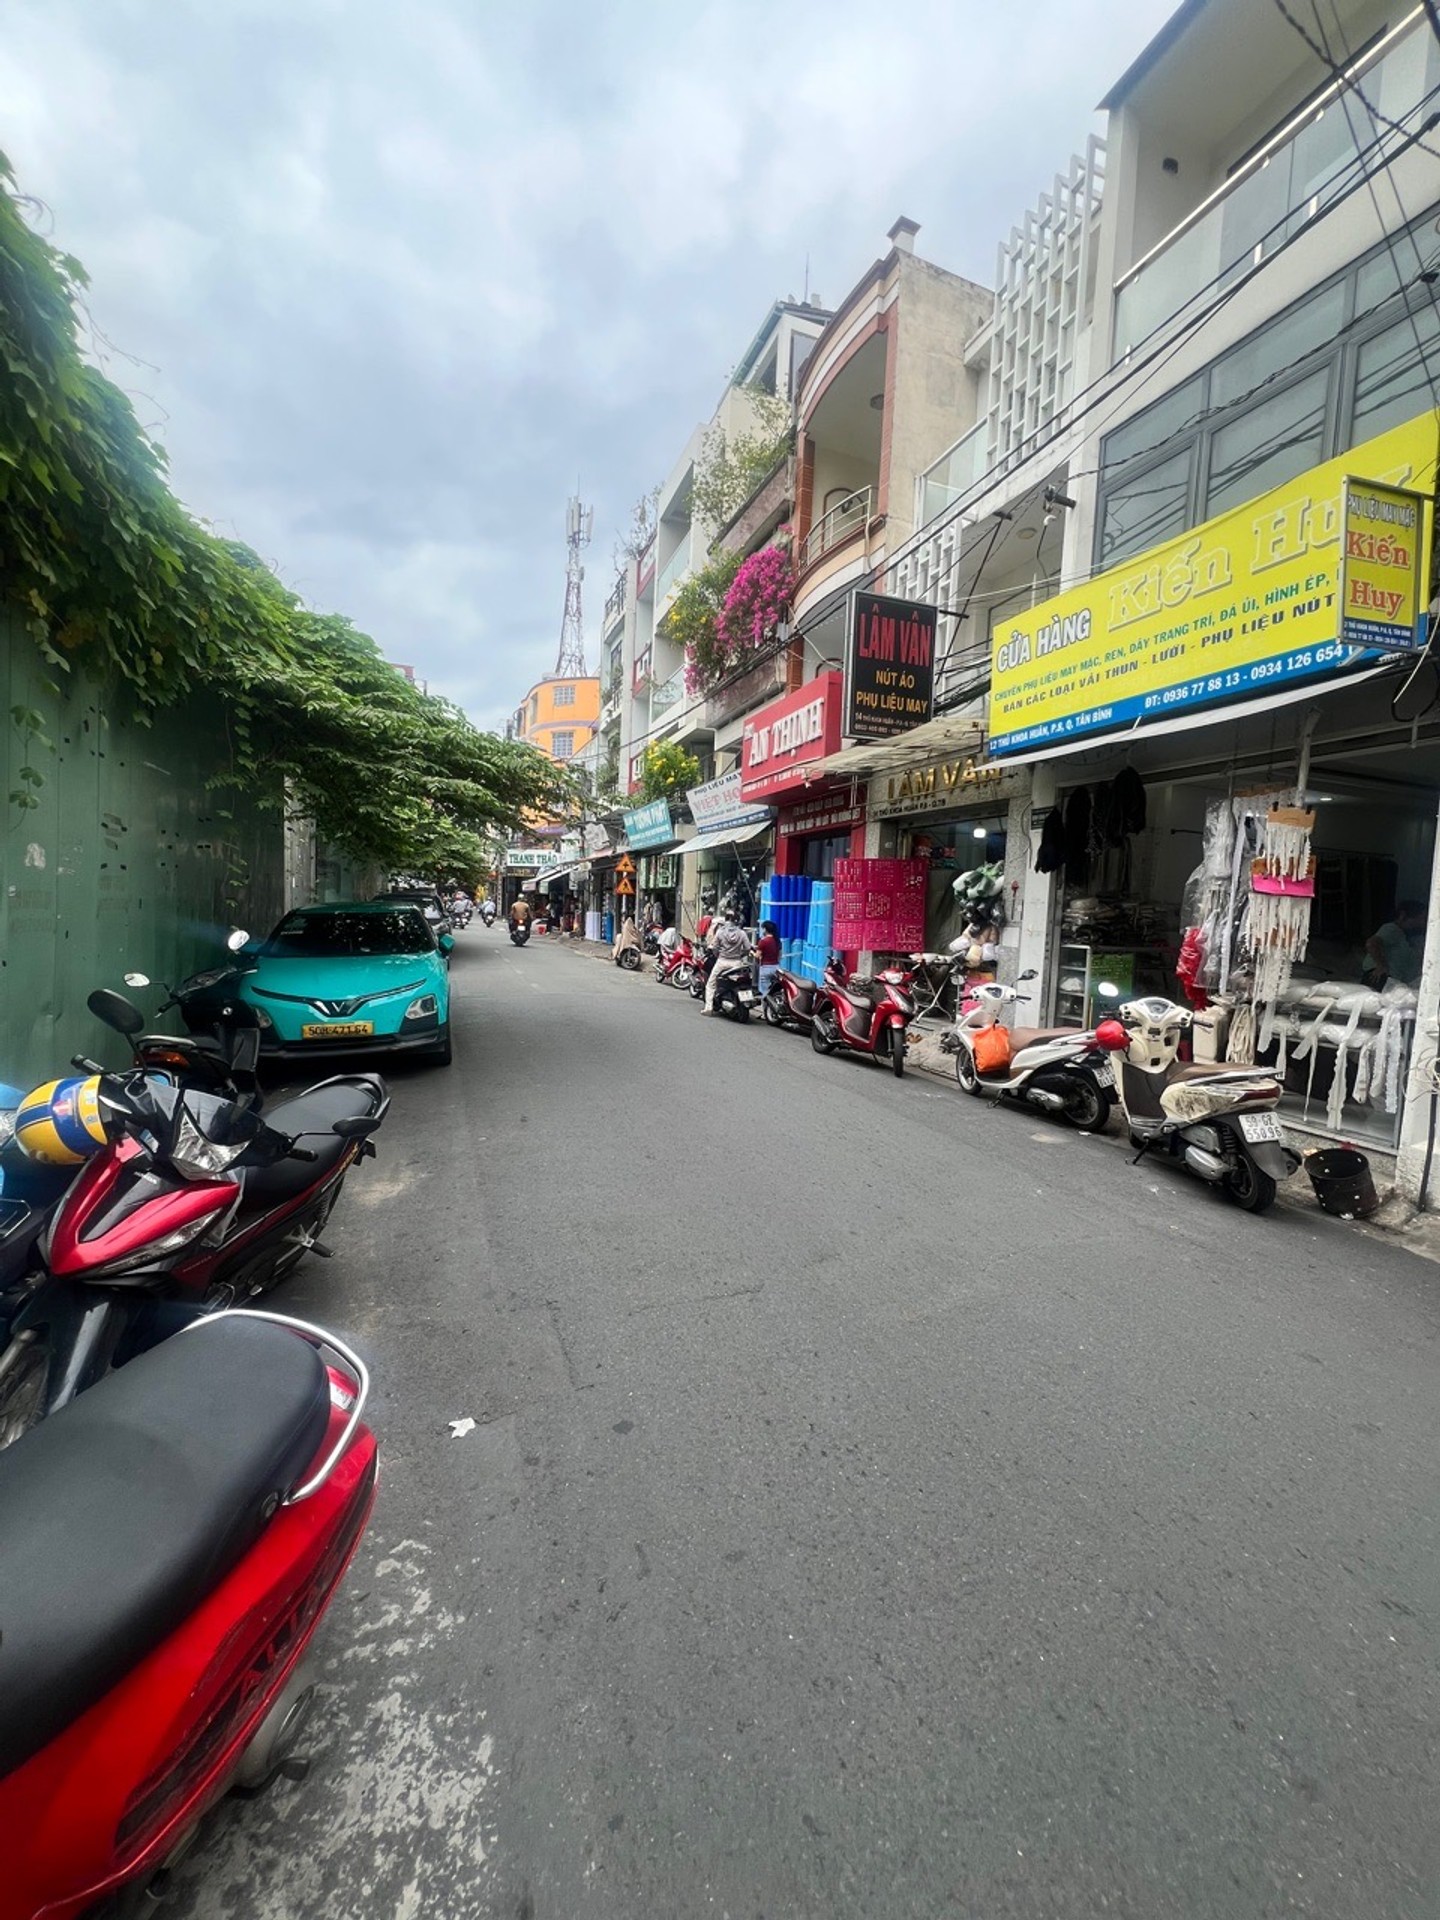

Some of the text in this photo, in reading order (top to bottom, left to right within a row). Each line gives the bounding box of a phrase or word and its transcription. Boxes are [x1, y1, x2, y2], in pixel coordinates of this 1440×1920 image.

[1381, 499, 1398, 526] MAY
[1399, 503, 1415, 533] MẶC
[1346, 530, 1410, 570] Kiến
[997, 629, 1032, 673] CỬA
[1036, 608, 1092, 658] HÀNG
[1108, 538, 1232, 632] Kiến
[1350, 579, 1403, 620] Huy
[859, 602, 932, 667] LÂM VÂN
[995, 686, 1022, 701] CHUYÊN
[1023, 679, 1038, 692] PHỤ
[1040, 670, 1058, 688] LIỆU
[1060, 664, 1078, 679] MAY
[1154, 623, 1189, 645] TRANG
[1193, 613, 1215, 631] TRÍ,
[1219, 606, 1237, 622] ĐÁ
[1265, 579, 1299, 605] HÌNH
[1026, 690, 1046, 707] CÁC
[1050, 681, 1075, 698] LOẠI
[1105, 660, 1138, 680] THUN
[1201, 627, 1233, 648] PHỤ
[1241, 610, 1284, 636] LIỆU
[1293, 593, 1336, 618] NÚT
[876, 667, 915, 689] NÚT ÁO
[1144, 696, 1161, 708] ĐT:
[1163, 686, 1189, 703] 0936
[1191, 683, 1204, 697] 77
[1207, 677, 1222, 692] 88
[1225, 673, 1240, 687] 13
[1251, 663, 1282, 681] 0934
[1287, 655, 1312, 670] 126
[1316, 645, 1343, 662] 654
[856, 691, 928, 714] PHỤ LIỆU MAY
[748, 697, 825, 767] AN THỊNH
[989, 741, 997, 750] 12
[1011, 732, 1029, 745] KHOA
[1076, 714, 1091, 727] TÂN
[1092, 706, 1113, 722] BÌNH
[888, 768, 937, 803] LÂM
